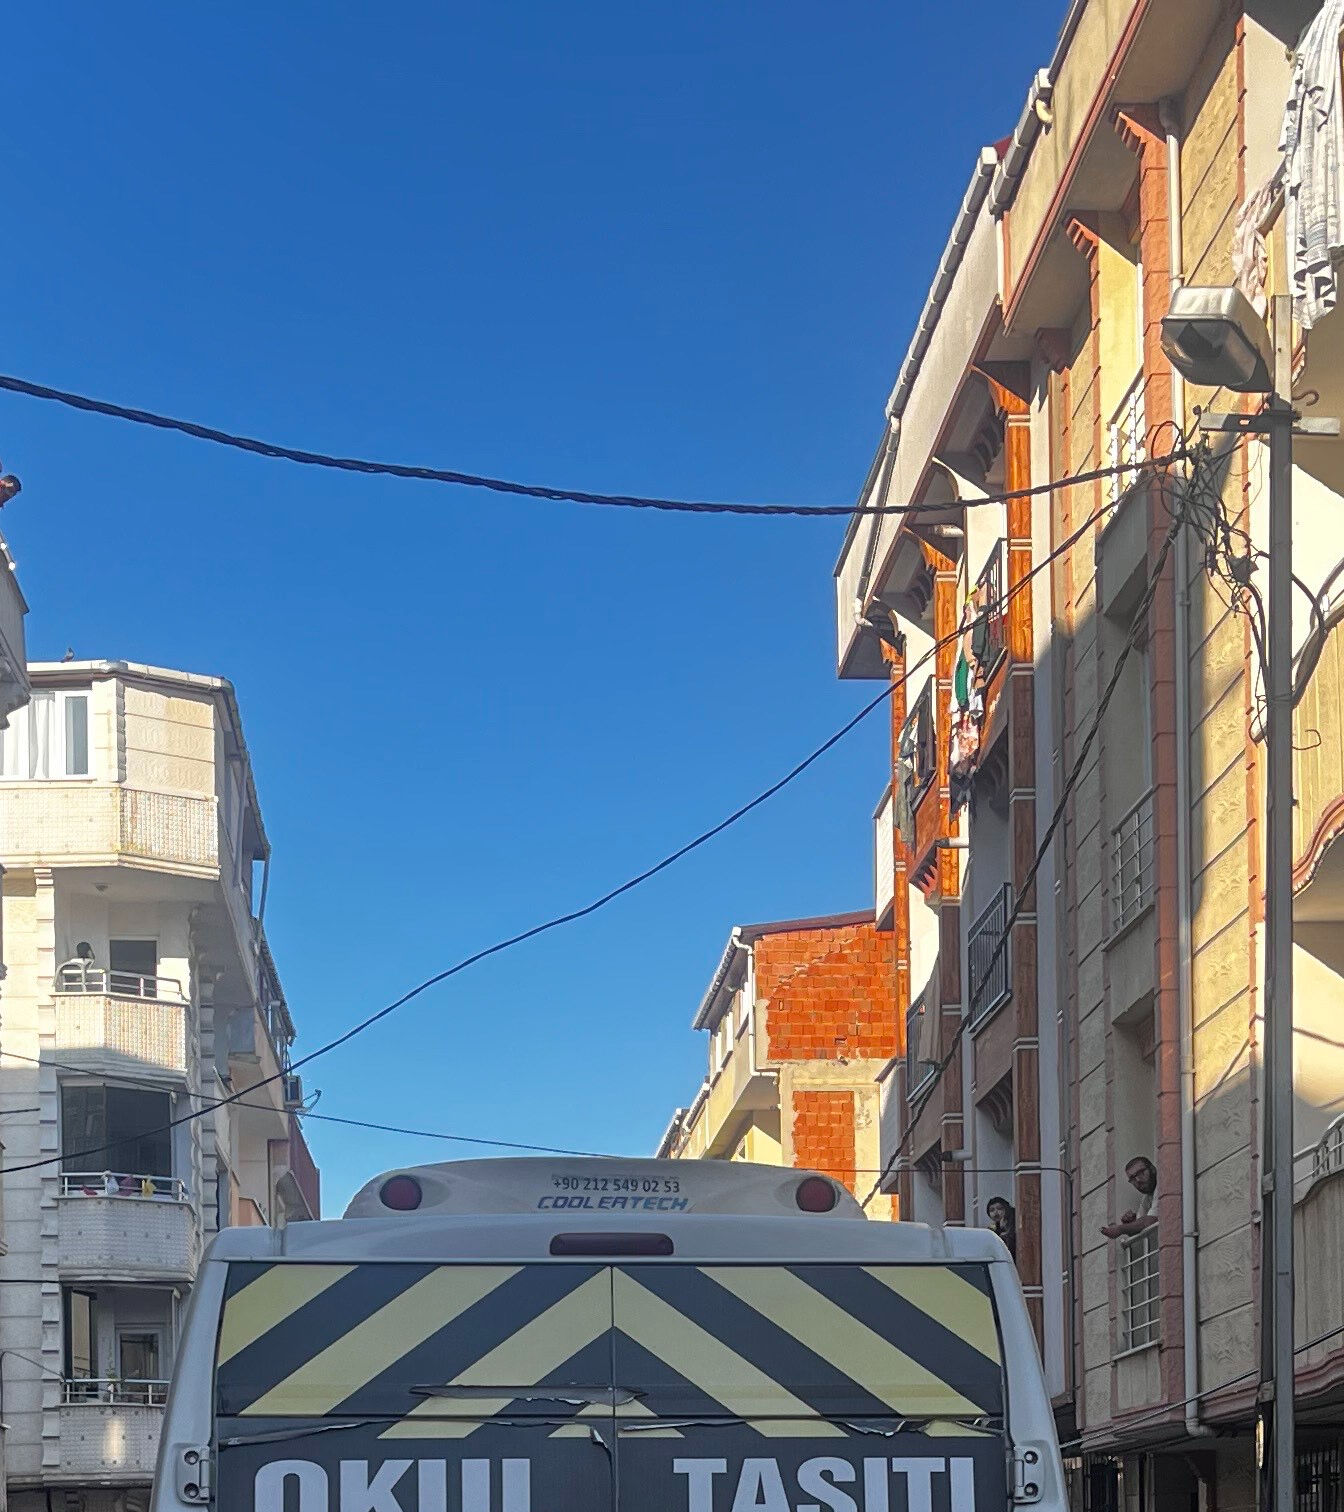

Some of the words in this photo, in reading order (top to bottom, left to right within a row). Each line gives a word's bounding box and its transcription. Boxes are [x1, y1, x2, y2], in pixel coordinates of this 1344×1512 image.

[553, 1178, 579, 1191] +90
[584, 1178, 609, 1191] 212
[613, 1178, 638, 1192] 549
[642, 1179, 660, 1193] 02
[664, 1180, 680, 1193] 53
